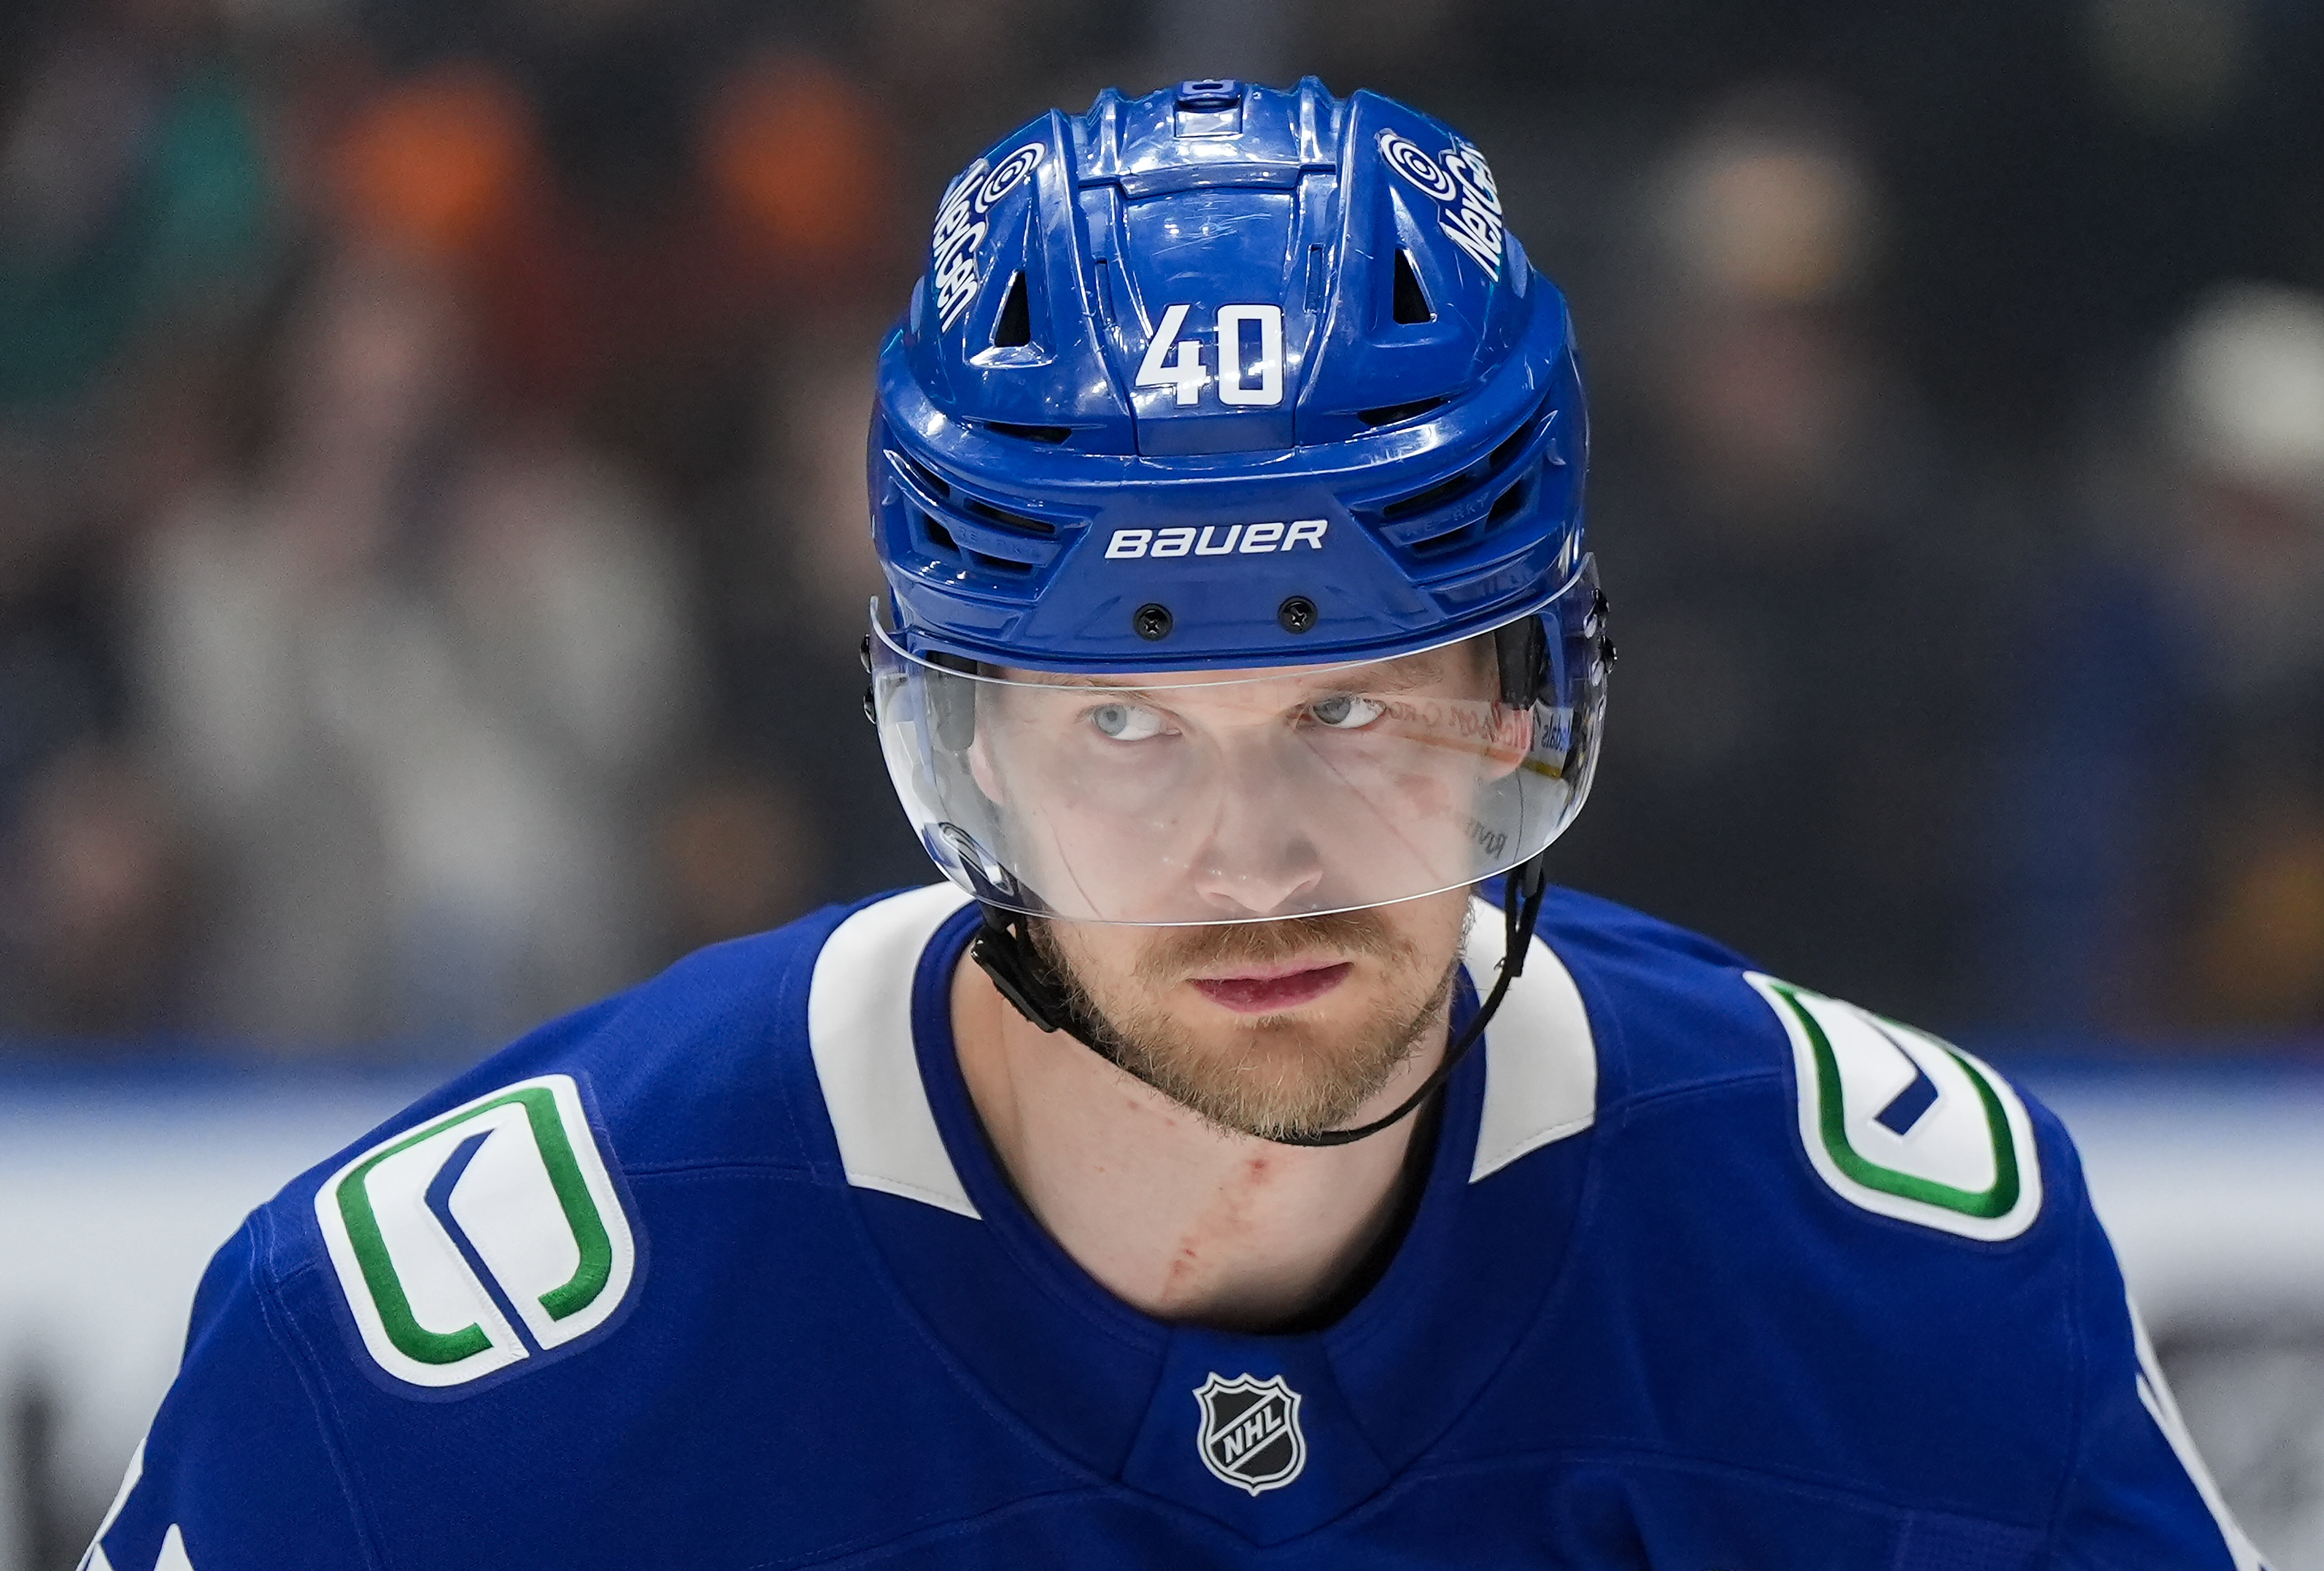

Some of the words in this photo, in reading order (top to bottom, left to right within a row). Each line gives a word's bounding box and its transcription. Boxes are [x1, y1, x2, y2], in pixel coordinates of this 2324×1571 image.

[932, 163, 985, 333] NexGen
[1136, 304, 1283, 405] 40
[1104, 519, 1328, 558] BAUER
[1223, 1405, 1282, 1463] NHL
